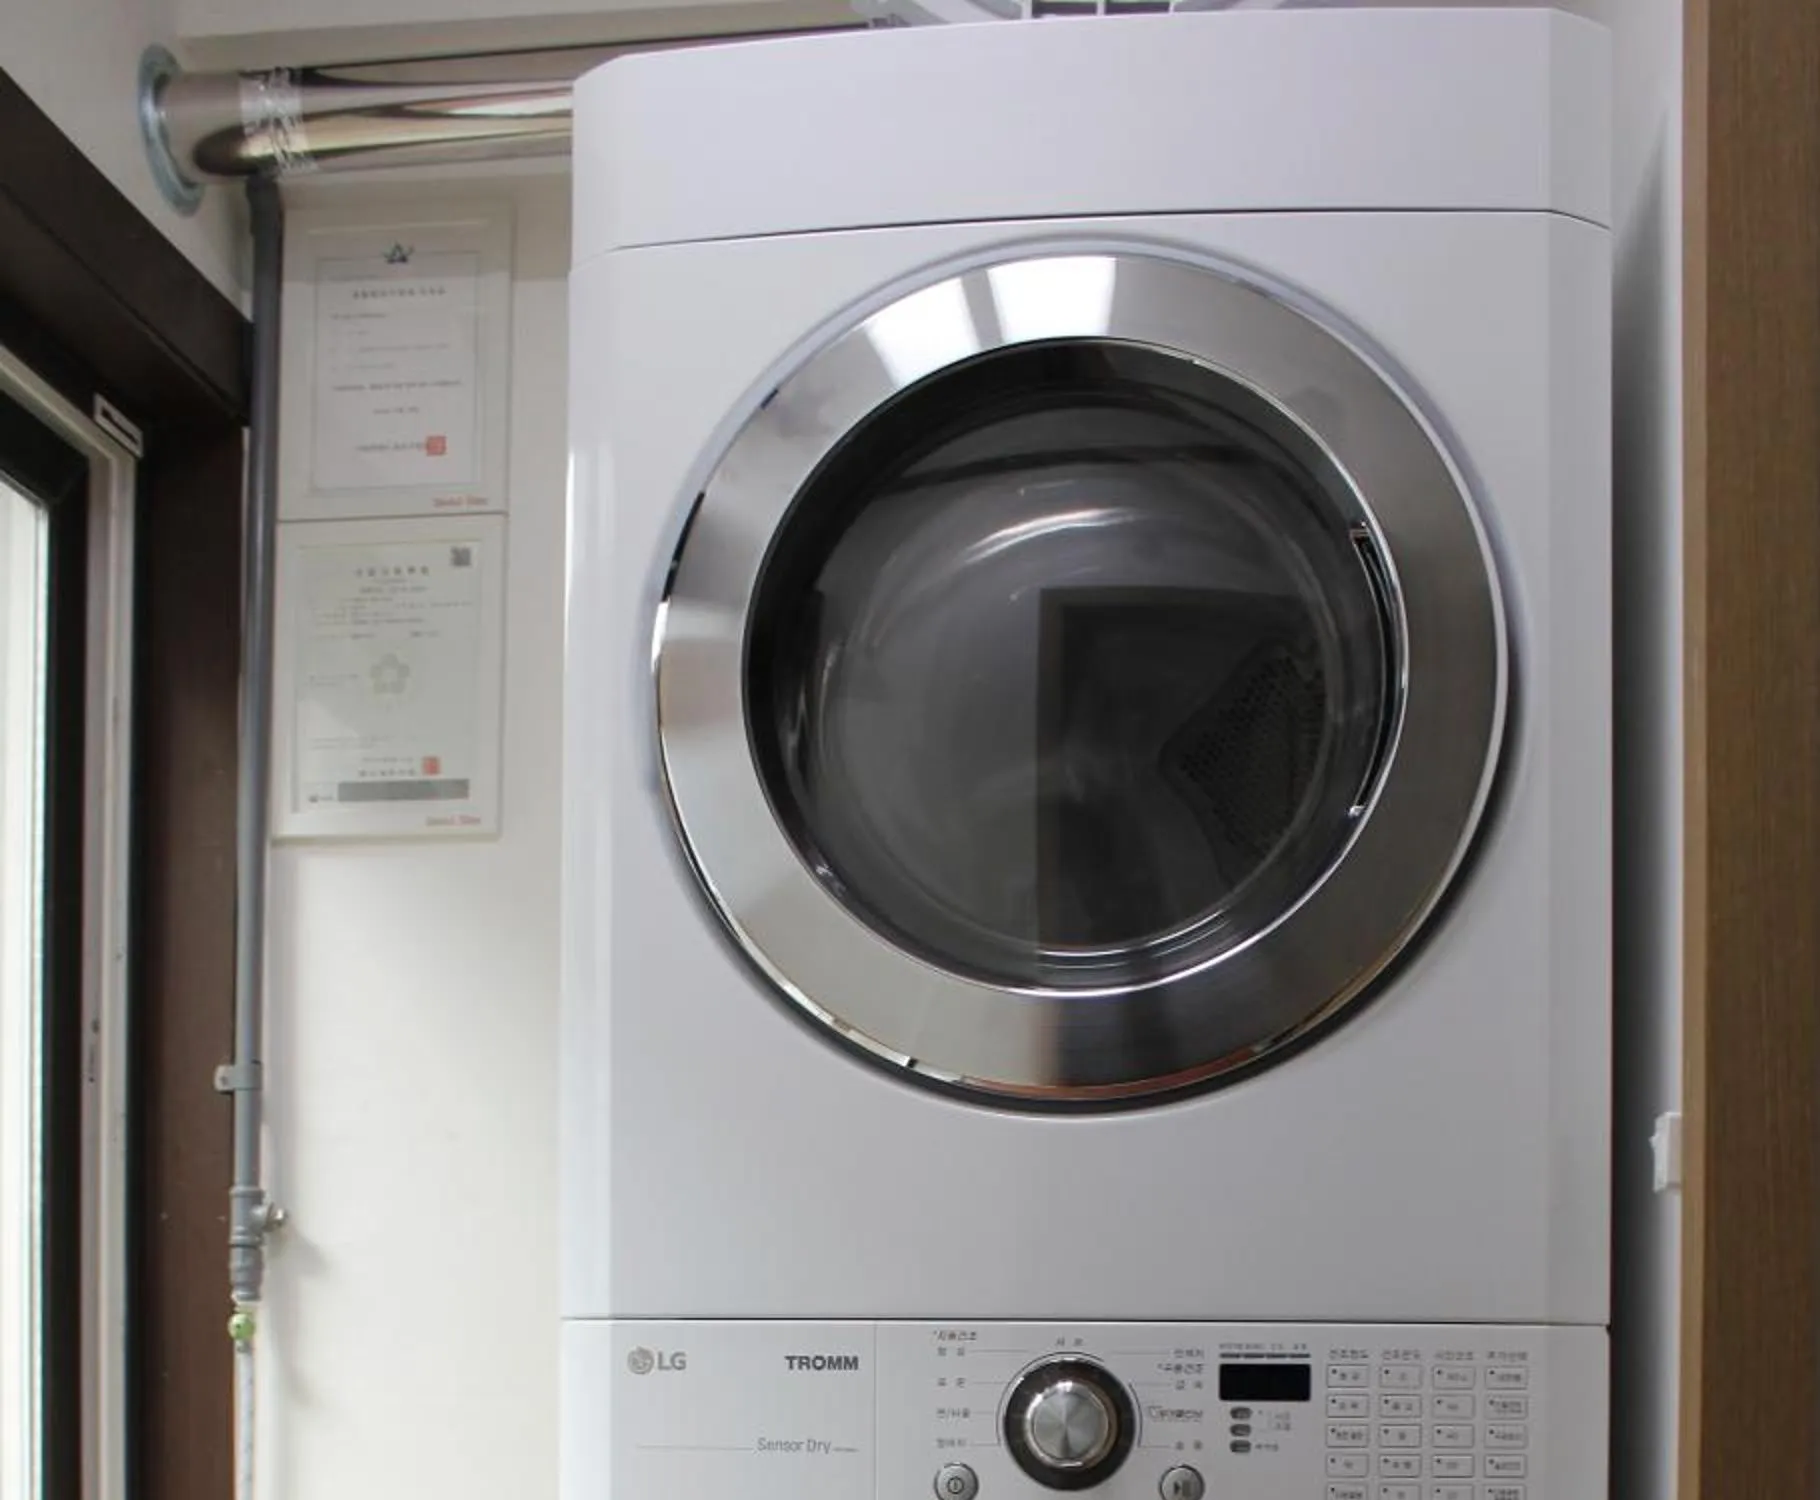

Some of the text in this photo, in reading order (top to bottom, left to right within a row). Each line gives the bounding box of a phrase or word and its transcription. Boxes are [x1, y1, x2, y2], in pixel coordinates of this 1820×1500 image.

[657, 1351, 687, 1371] LG
[784, 1354, 860, 1371] TROMM
[756, 1436, 832, 1455] Sensor Dry
